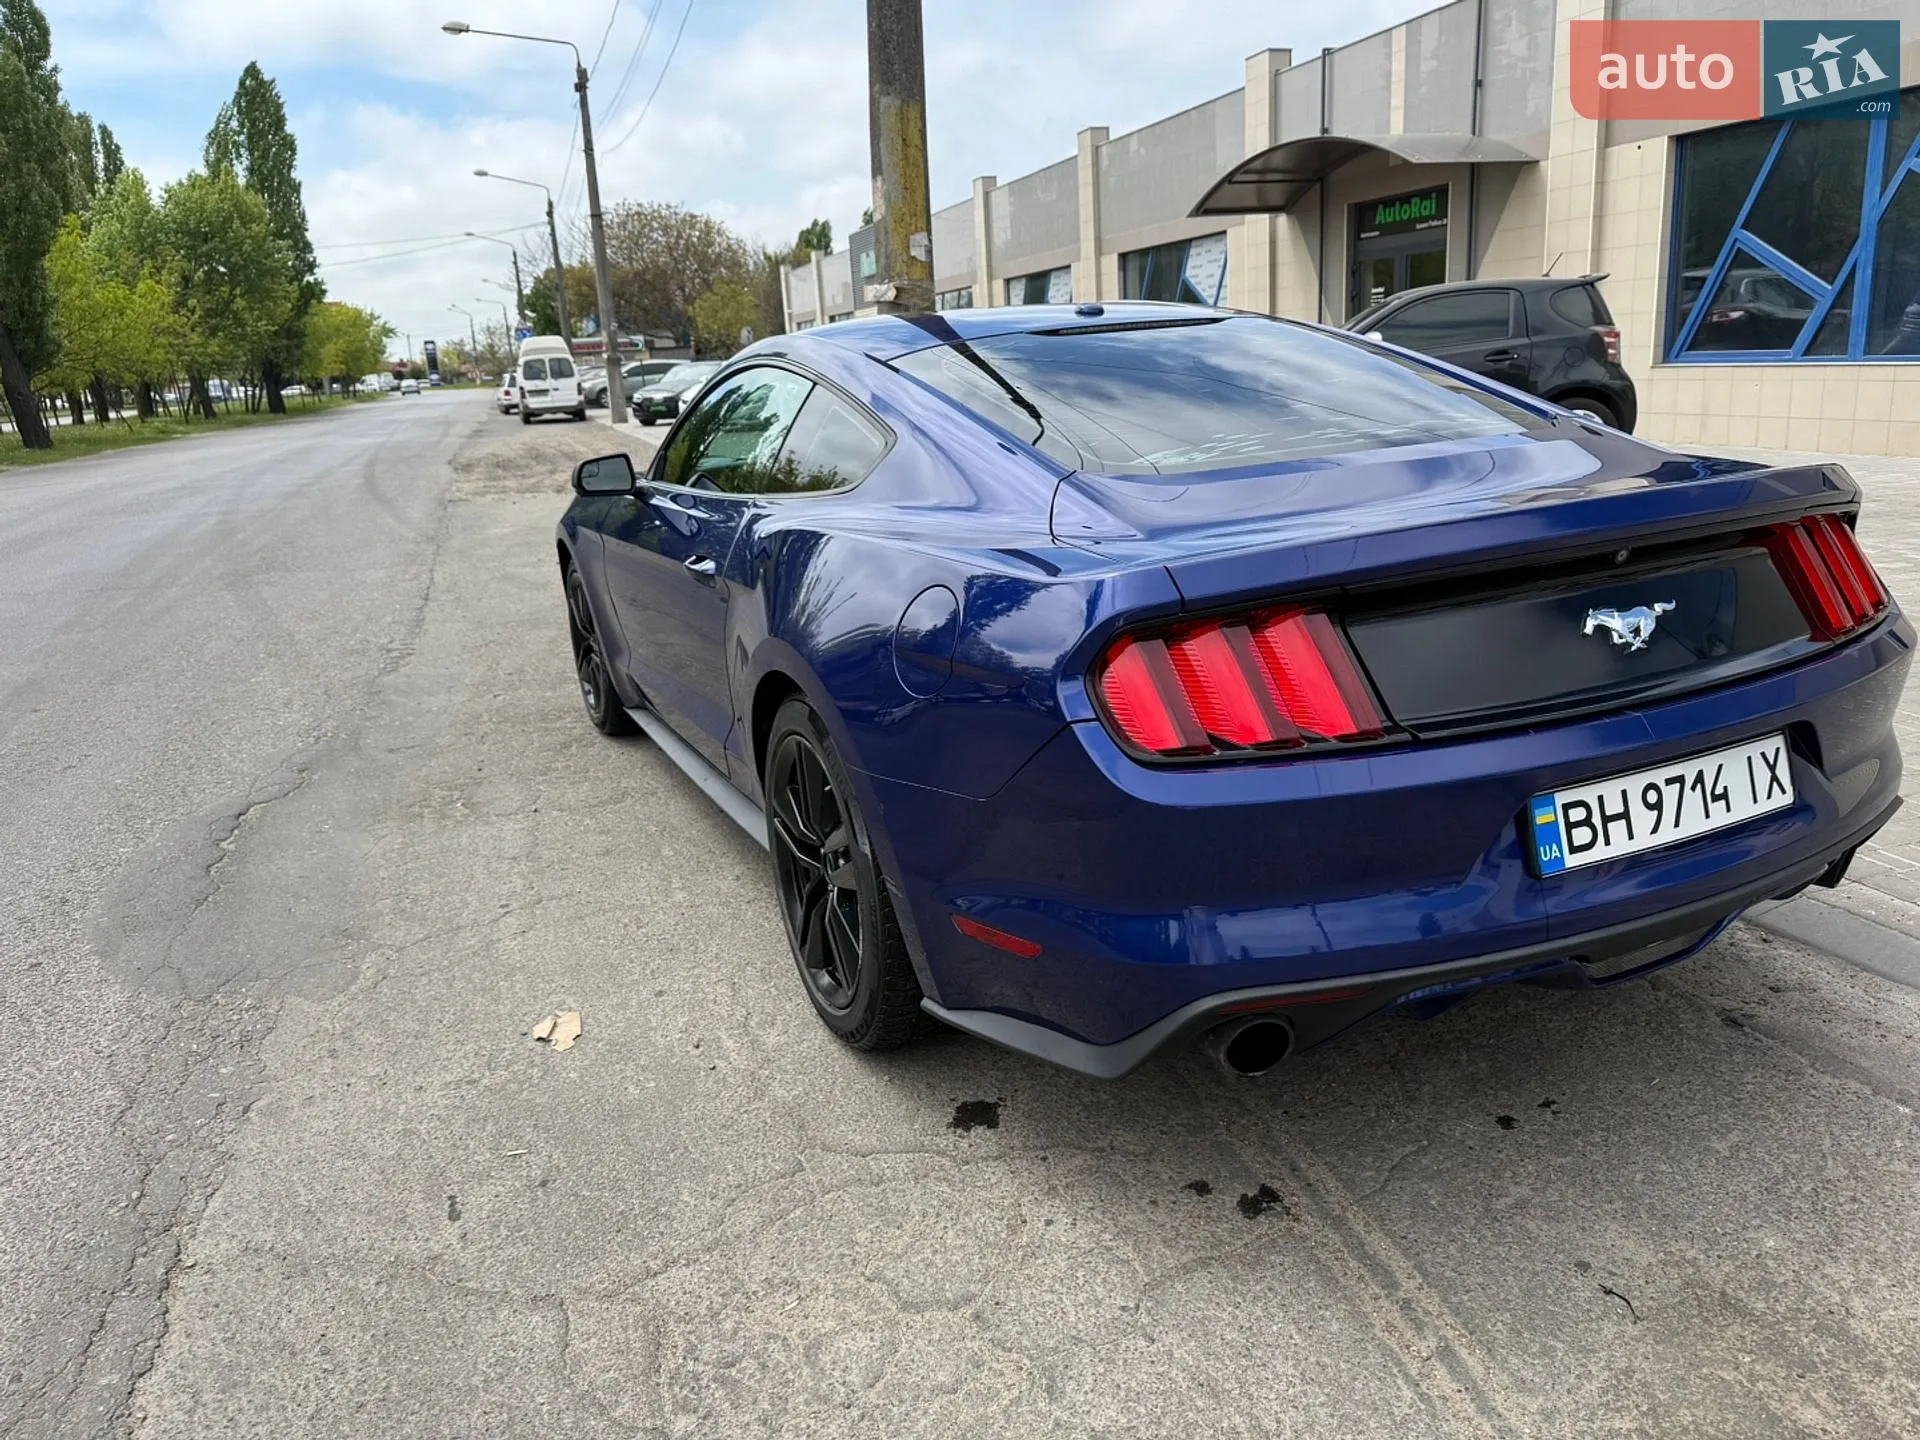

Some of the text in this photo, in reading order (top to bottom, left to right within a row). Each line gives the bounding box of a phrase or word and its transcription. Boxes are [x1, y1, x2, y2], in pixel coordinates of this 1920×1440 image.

[1375, 192, 1437, 225] AutoRai
[1561, 746, 1787, 856] BH 9714 IX
[1540, 842, 1561, 861] UA
